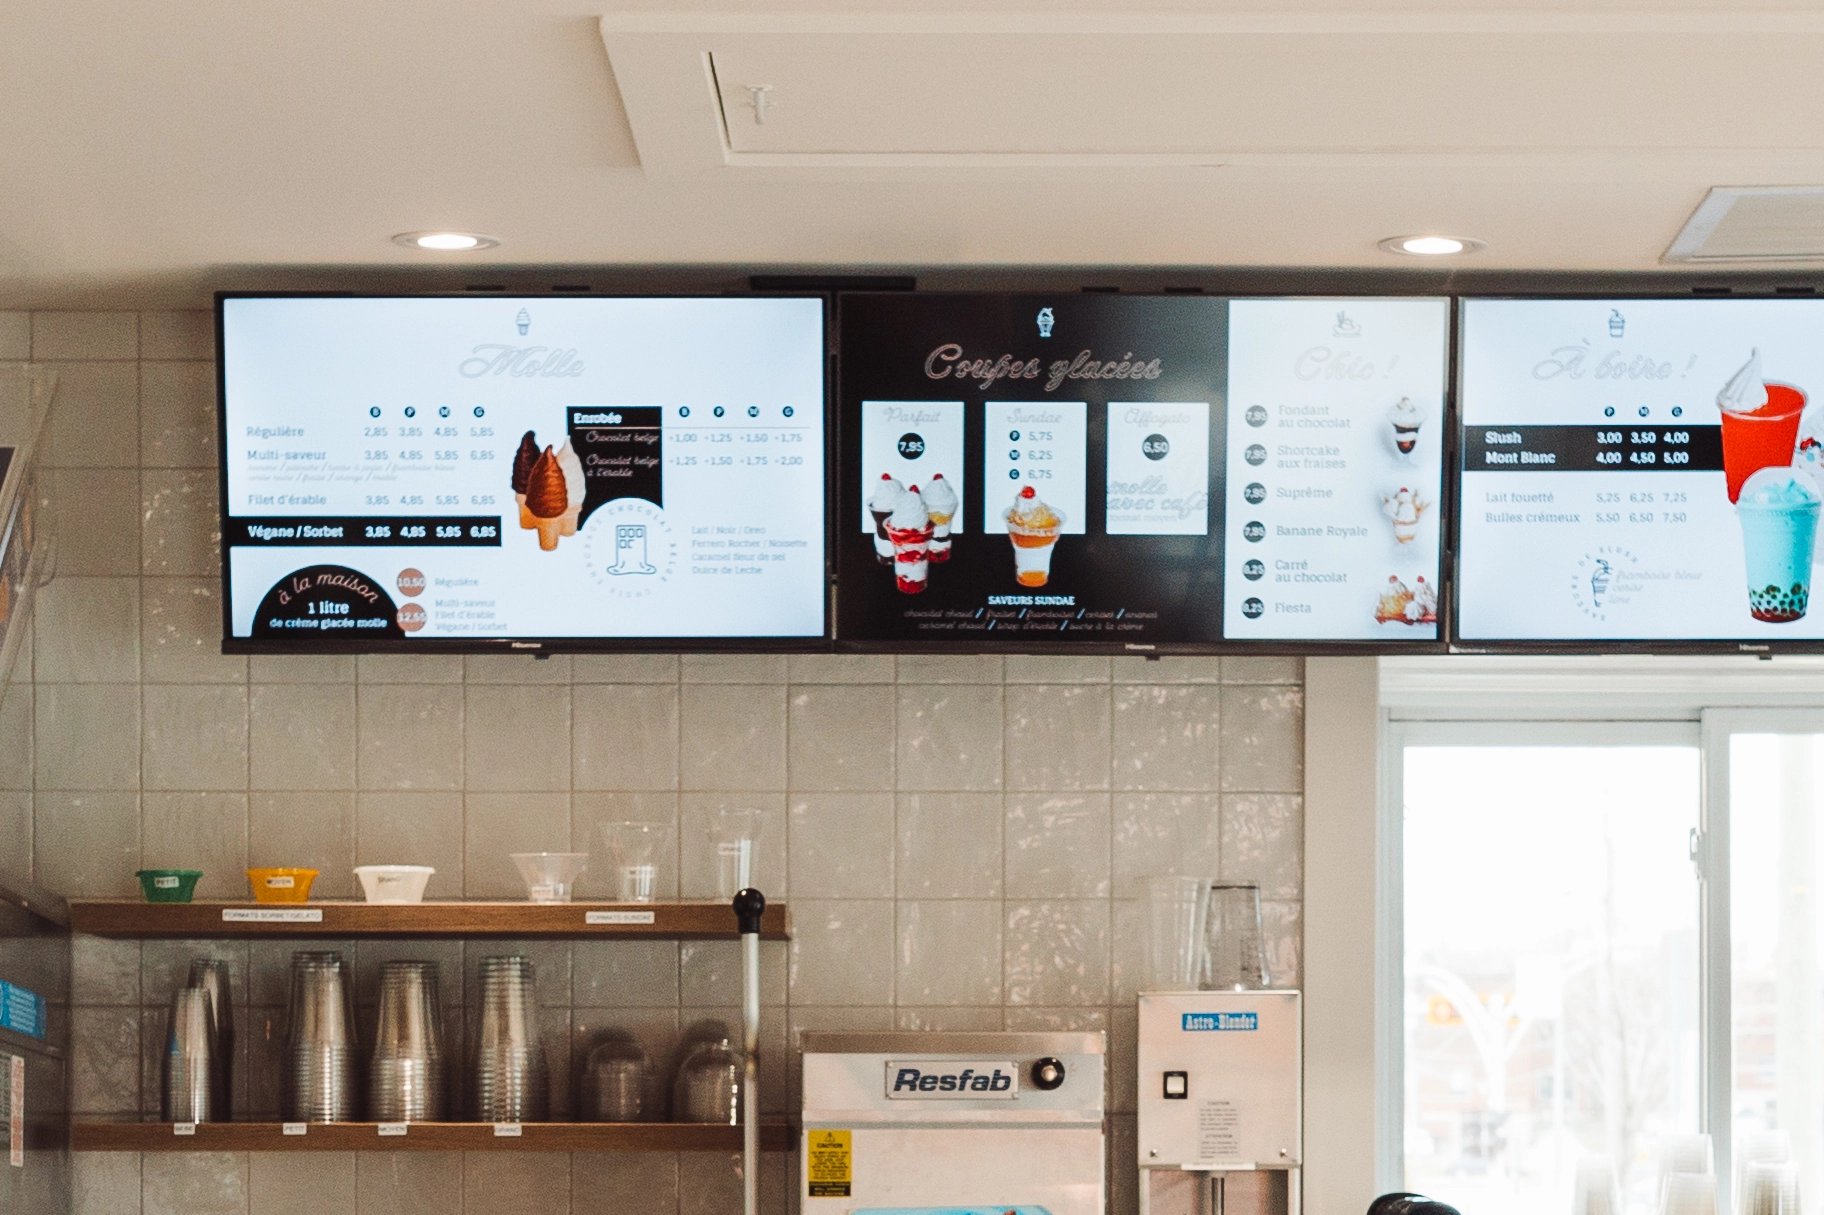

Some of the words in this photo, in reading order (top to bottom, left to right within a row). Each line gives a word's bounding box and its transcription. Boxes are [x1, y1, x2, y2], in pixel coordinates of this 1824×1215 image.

[458, 344, 585, 378] Molle
[1595, 350, 1673, 380] boire
[926, 344, 1040, 390] Coupes
[1045, 350, 1162, 392] glacées
[884, 408, 941, 424] Parfait
[1007, 408, 1062, 424] Sundae
[1279, 405, 1329, 415] Fondant
[1278, 420, 1295, 428] au
[1297, 418, 1351, 428] chocolat
[247, 426, 304, 439] Régulière
[1485, 431, 1521, 444] Slush
[248, 450, 326, 460] Multi-saveur
[1278, 445, 1340, 456] Shortcake
[1278, 460, 1299, 468] aux
[1304, 458, 1346, 469] fraises
[1486, 452, 1518, 464] Mont
[1521, 452, 1556, 464] Blanc
[248, 495, 274, 505] Filet
[278, 494, 326, 505] d'érable
[1278, 487, 1333, 500] Suprême
[1486, 492, 1508, 502] Lait
[1511, 492, 1554, 502] fouetté
[1486, 513, 1523, 522] Bulles
[248, 525, 293, 540] Végane
[304, 525, 343, 537] Sorbet
[1277, 526, 1323, 536] Banane
[1327, 526, 1367, 538] Royale
[1276, 560, 1308, 570] Carré
[1276, 574, 1291, 582] au
[1294, 572, 1347, 582] chocolat
[293, 577, 309, 593] la
[316, 573, 378, 603] maison
[988, 596, 1033, 605] SAVEURS
[1035, 596, 1075, 605] SUNDAE
[308, 603, 315, 614] 1
[320, 601, 349, 614] litre
[1275, 603, 1311, 613] Fiesta
[270, 618, 282, 628] de
[285, 618, 318, 628] crème
[321, 618, 354, 630] glacée
[357, 618, 387, 628] molle
[156, 878, 177, 886] PETIT
[266, 878, 292, 886] MOYEN
[1186, 1014, 1257, 1031] Astro-Blender
[893, 1068, 1012, 1093] Resfab
